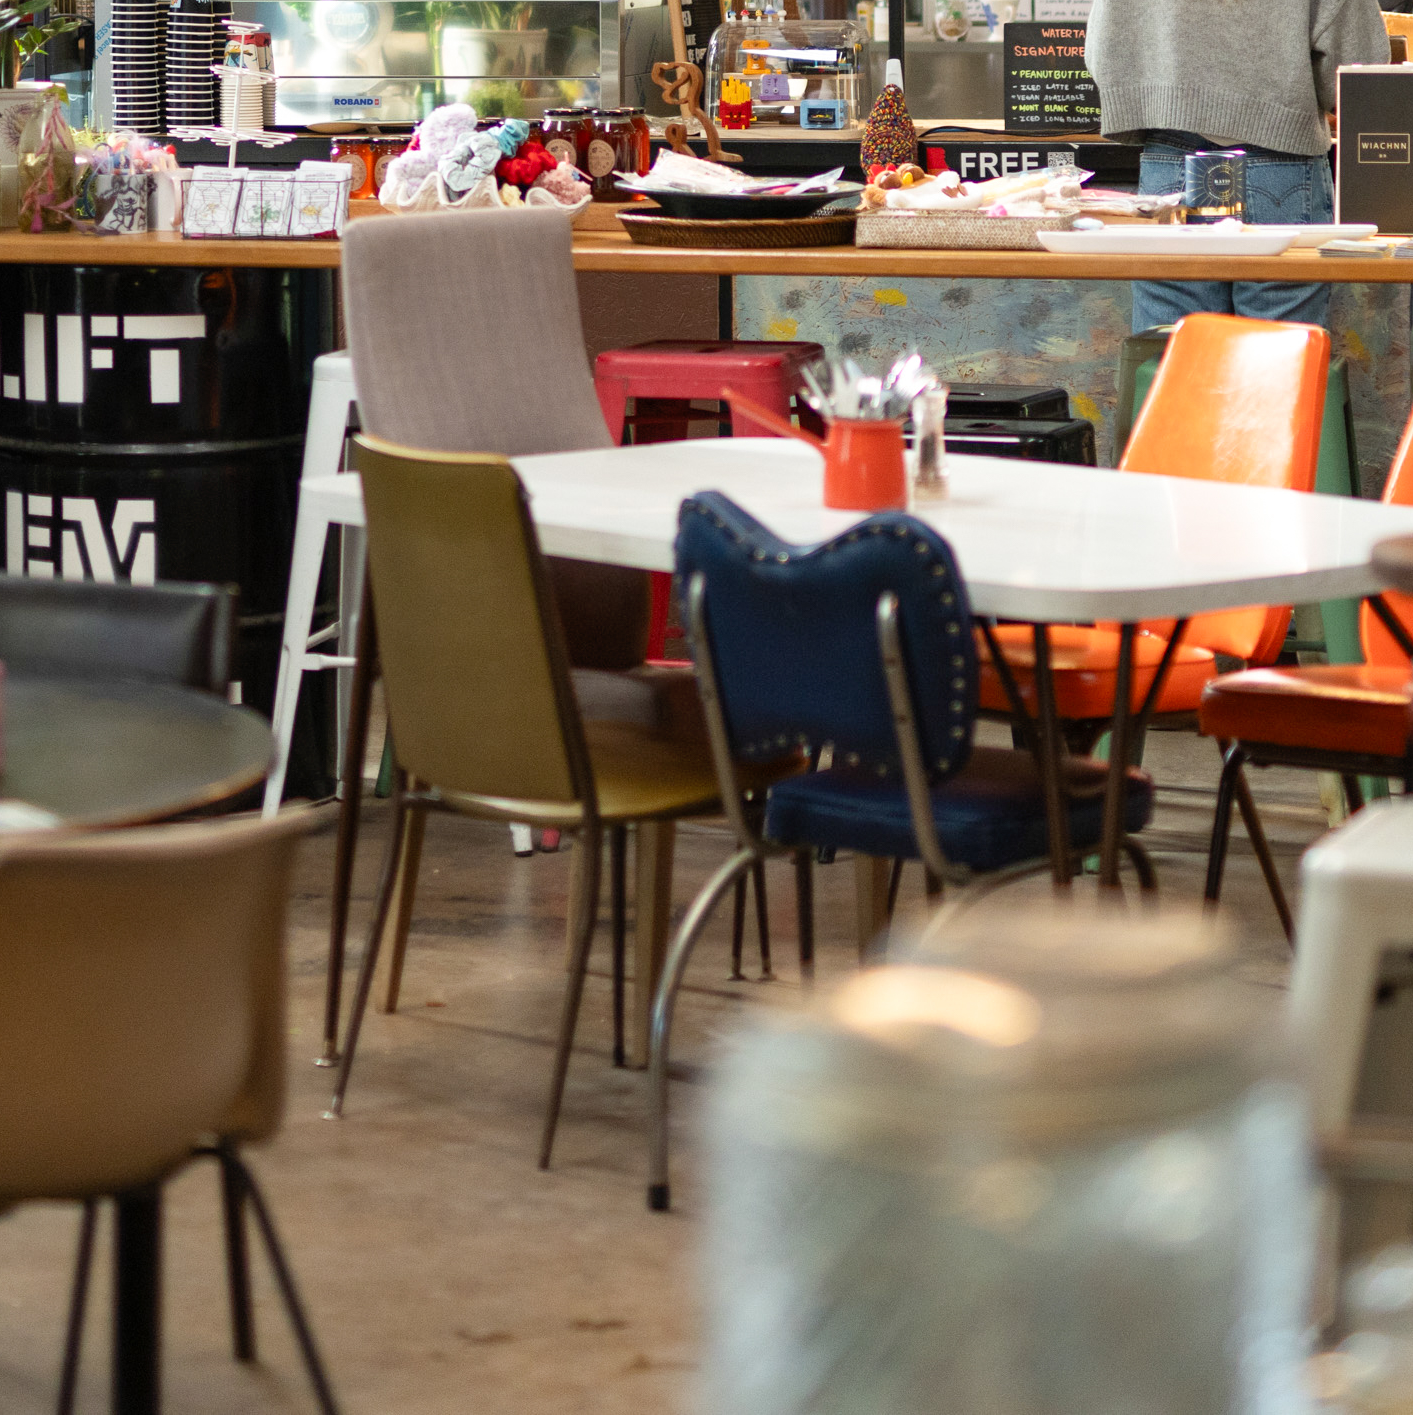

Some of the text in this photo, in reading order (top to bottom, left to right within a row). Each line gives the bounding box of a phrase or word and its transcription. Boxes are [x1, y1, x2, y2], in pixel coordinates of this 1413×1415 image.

[1041, 28, 1086, 39] WATERTA
[1014, 45, 1085, 58] SIGNATURE
[1045, 83, 1070, 92] LATTE
[334, 98, 374, 106] ROBAND
[1043, 93, 1086, 102] AVAILABLE
[1018, 104, 1102, 115] MONT BLANC COFFE
[1019, 115, 1041, 123] ICED
[1361, 142, 1408, 151] WIACHNN
[960, 151, 1040, 179] FREE
[5, 490, 156, 586] EM
